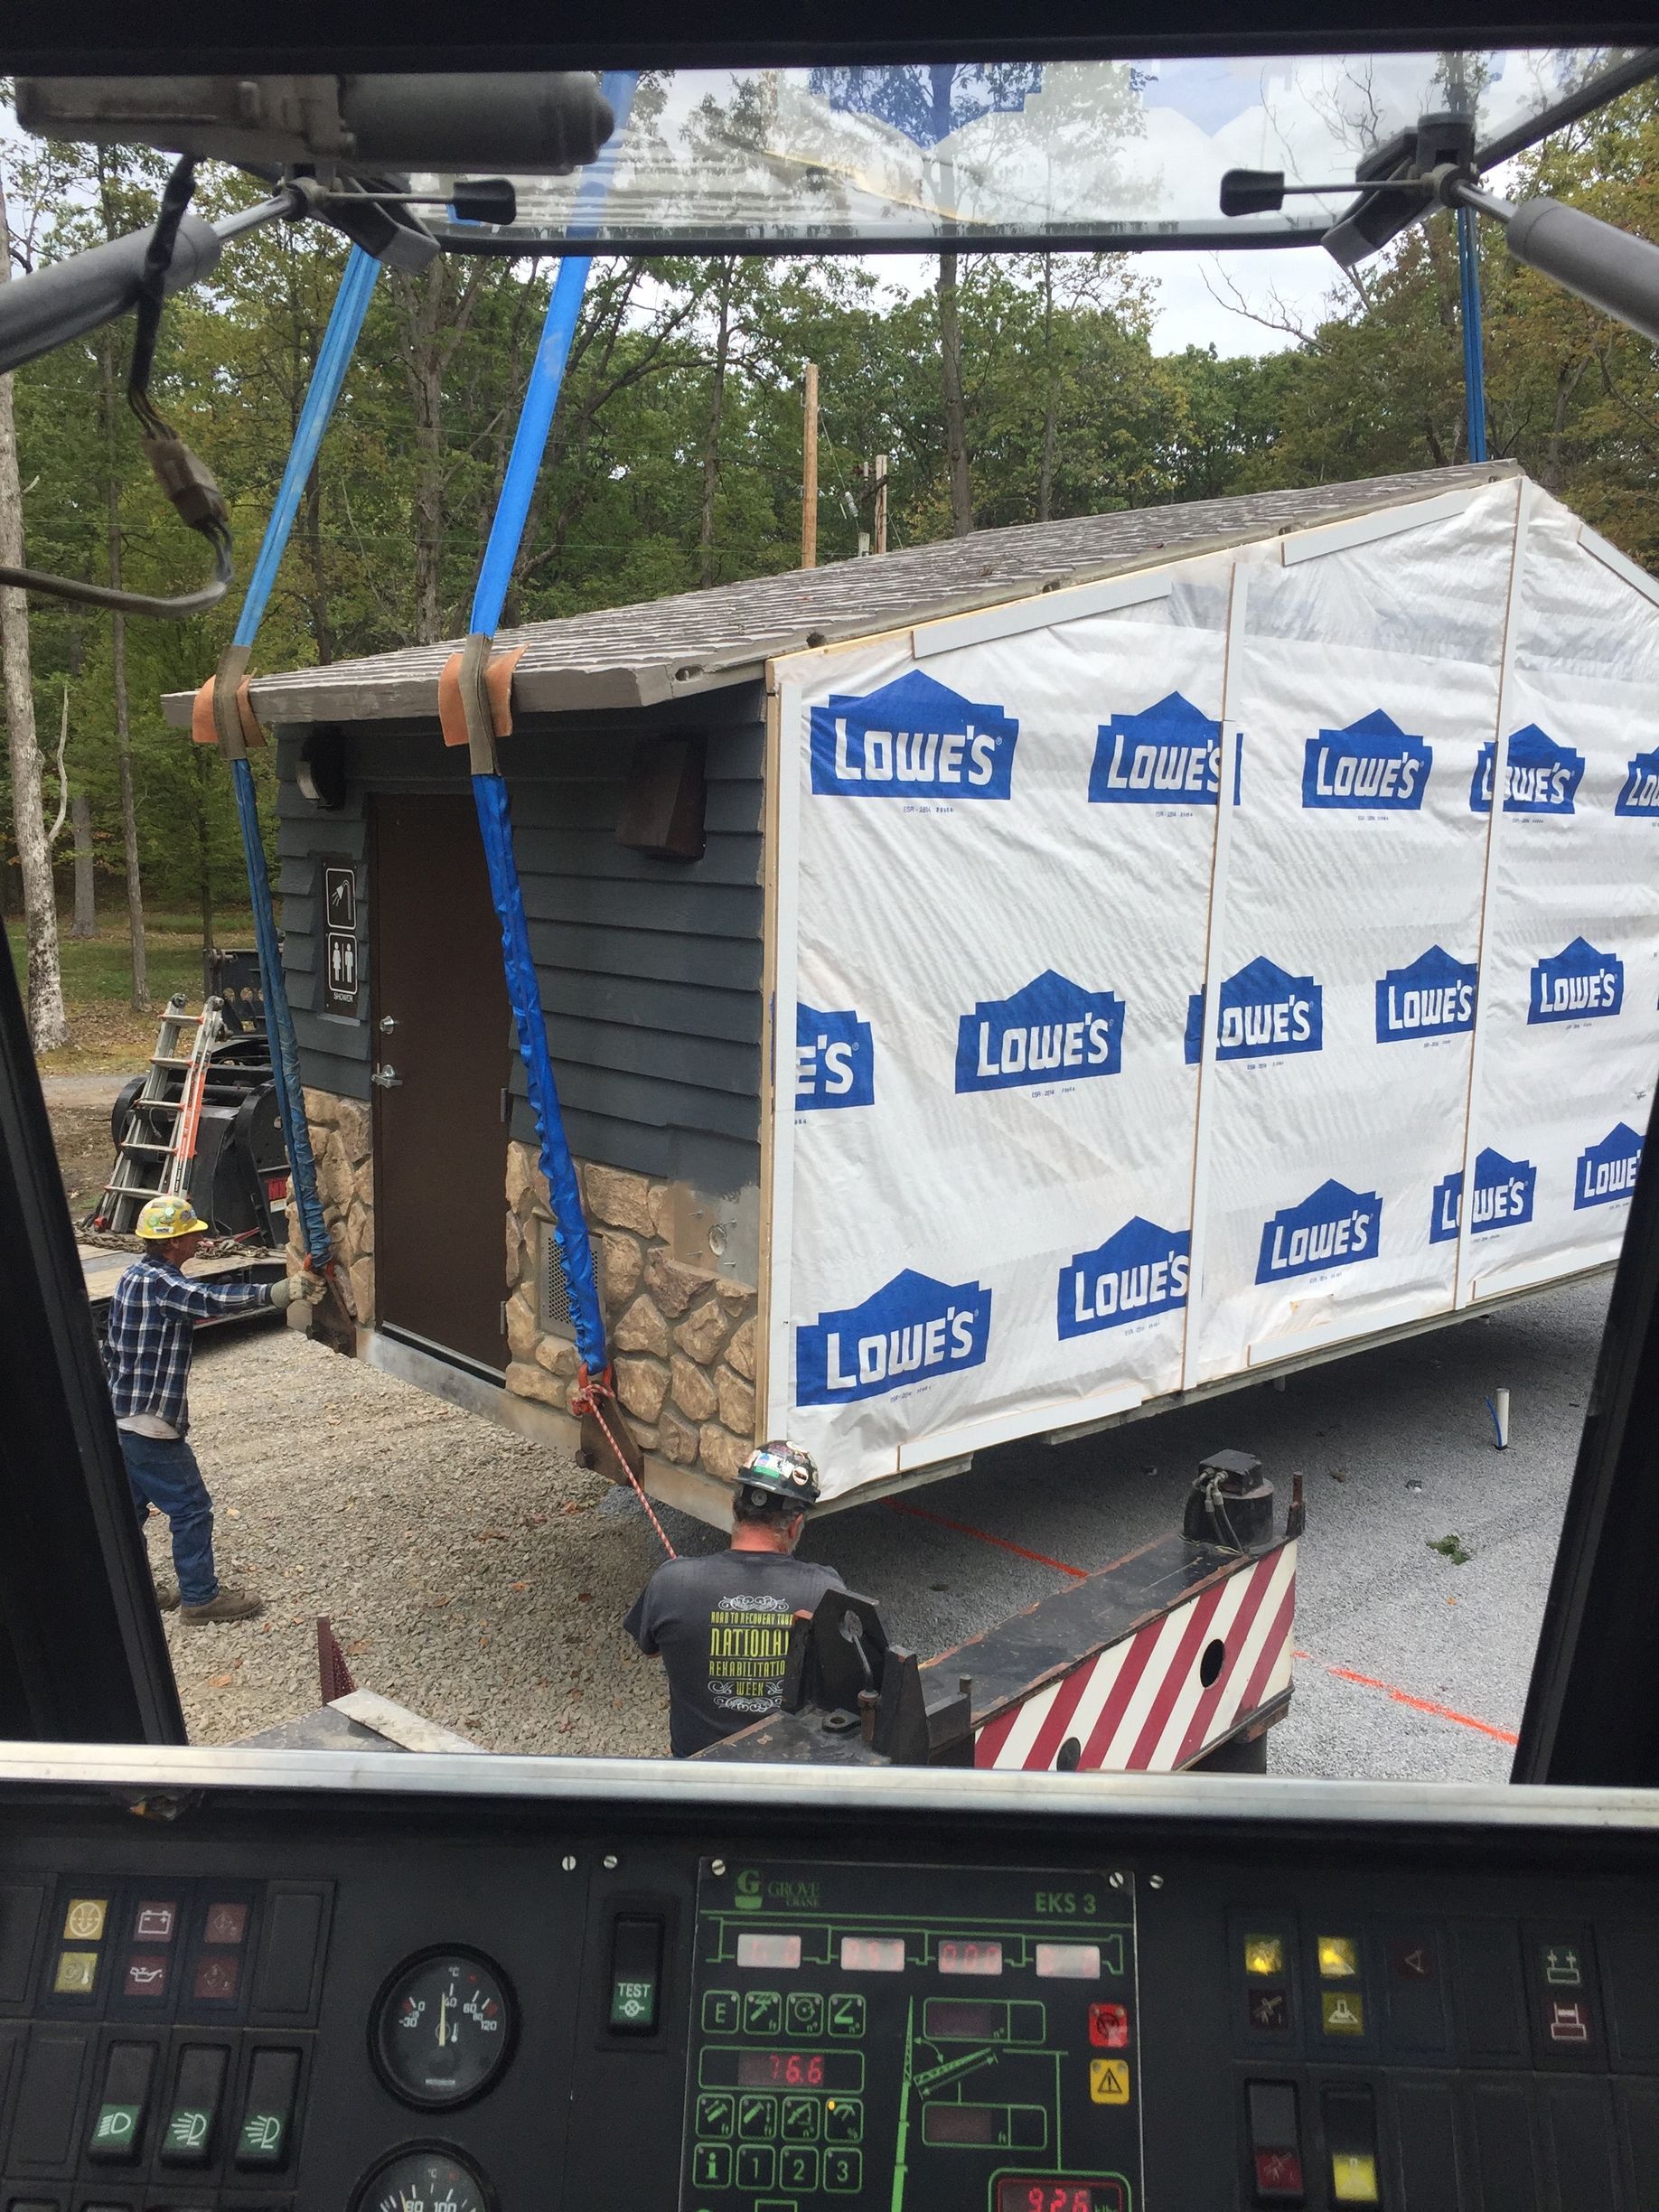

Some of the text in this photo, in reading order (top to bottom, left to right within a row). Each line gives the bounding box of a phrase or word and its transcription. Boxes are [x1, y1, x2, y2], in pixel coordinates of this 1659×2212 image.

[835, 718, 995, 785] LOWE'S
[1107, 735, 1221, 790] LOWE'S
[1316, 746, 1420, 799] LOWE'S
[333, 991, 353, 1003] SHOWER
[1388, 979, 1474, 1030] LOWE'S
[1539, 968, 1616, 1013] LOWE'S
[1216, 994, 1311, 1047] OWE'S
[978, 1011, 1109, 1076] LOWE'S
[1270, 1209, 1370, 1270] LOWE'S
[1074, 1251, 1189, 1323] LOWE'S
[826, 1307, 973, 1390] LOWE'S
[710, 1611, 729, 1624] ROAD
[731, 1612, 739, 1624] TO
[740, 1612, 775, 1625] RECOVERY
[708, 1660, 786, 1677] REHABILITATIO
[736, 1682, 764, 1696] WEEK
[1036, 1892, 1096, 1914] EKS 3
[618, 1982, 651, 1998] TEST
[716, 2002, 726, 2023] E
[753, 2157, 759, 2179] 1
[793, 2159, 804, 2180] 2
[837, 2160, 848, 2182] 3
